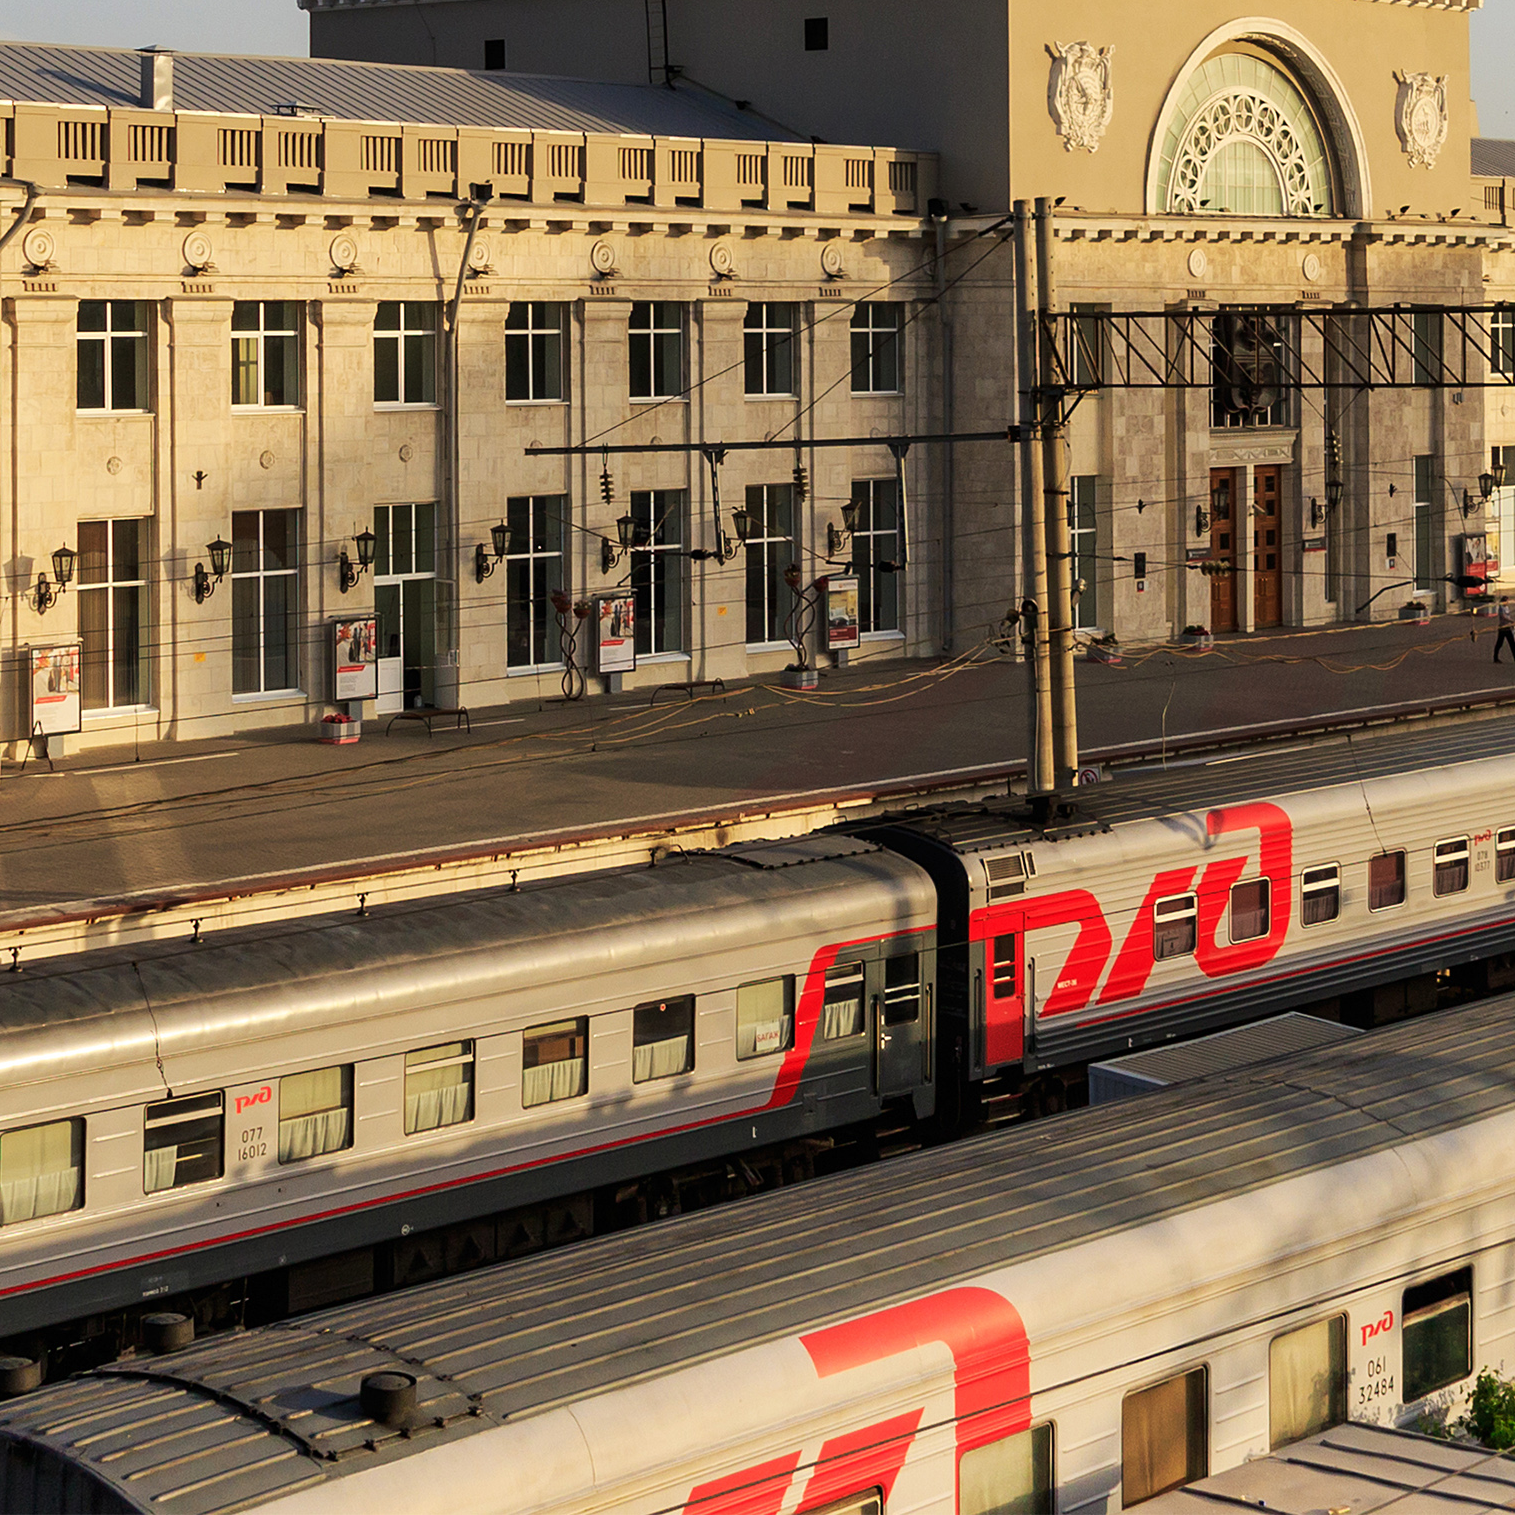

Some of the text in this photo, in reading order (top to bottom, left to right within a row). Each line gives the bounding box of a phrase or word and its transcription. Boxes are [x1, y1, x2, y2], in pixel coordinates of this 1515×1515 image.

[241, 1126, 263, 1143] 077
[238, 1142, 267, 1161] 16012
[1367, 1355, 1386, 1378] 061
[1358, 1375, 1394, 1405] 32484
